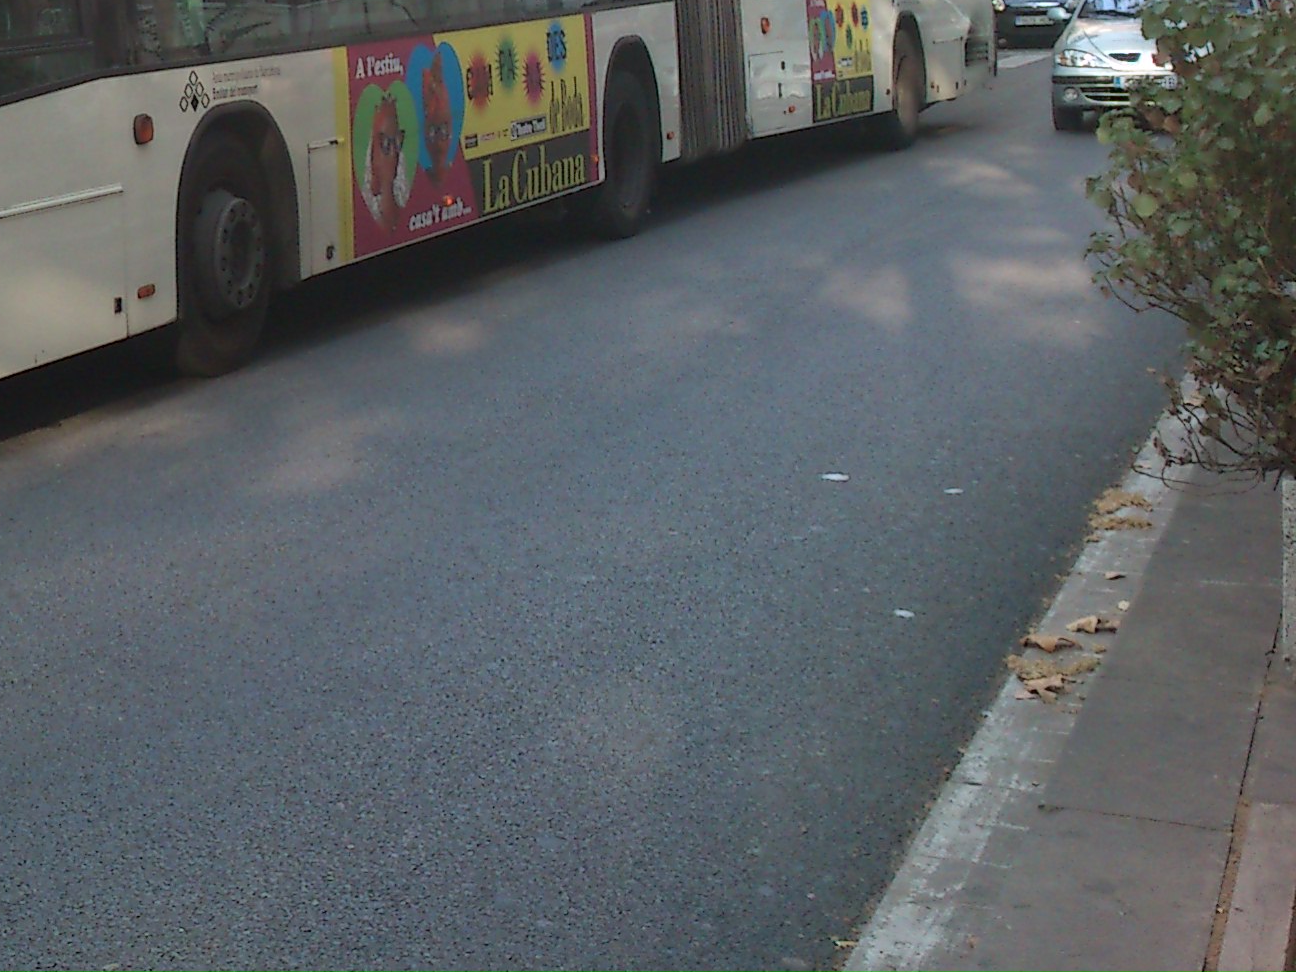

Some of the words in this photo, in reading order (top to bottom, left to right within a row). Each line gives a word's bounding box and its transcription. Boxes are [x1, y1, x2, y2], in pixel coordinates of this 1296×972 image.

[355, 56, 366, 79] A
[482, 158, 512, 214] La
[512, 143, 586, 205] Cubana
